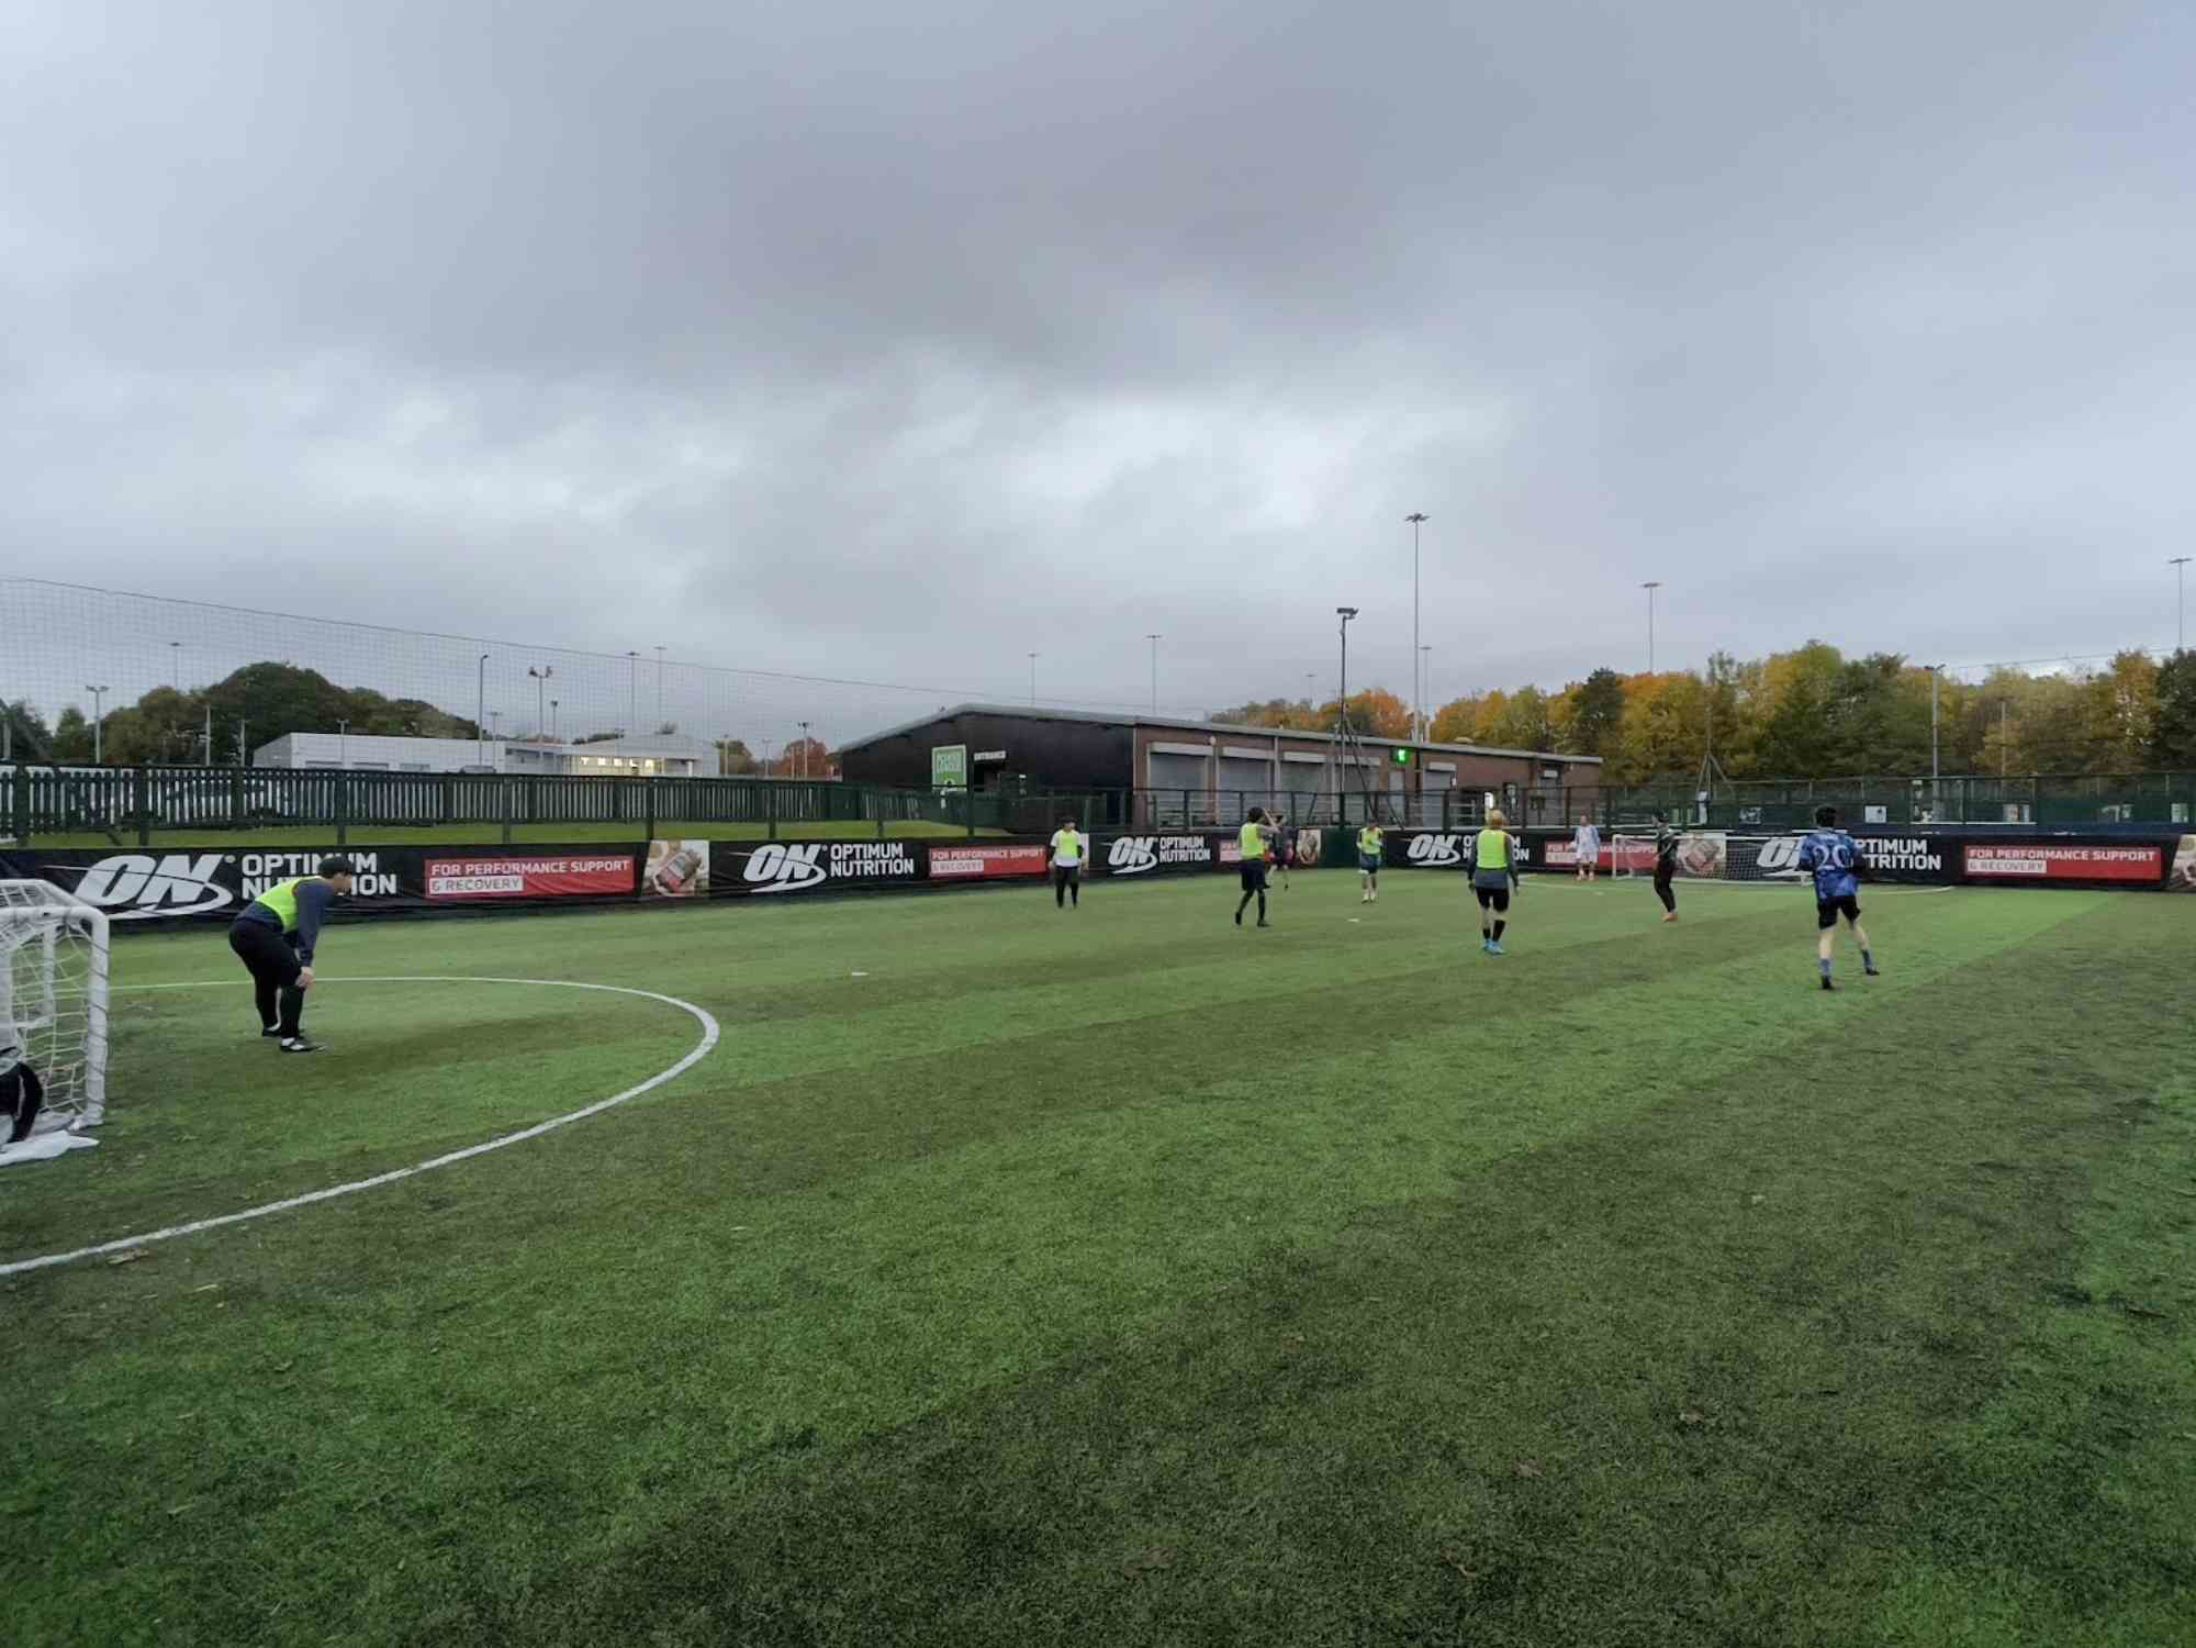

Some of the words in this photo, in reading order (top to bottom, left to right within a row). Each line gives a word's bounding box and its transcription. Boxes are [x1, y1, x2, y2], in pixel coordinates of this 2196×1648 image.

[830, 843, 903, 859] OPTIMUM
[1159, 837, 1204, 850] OPTIMUM
[1854, 838, 1927, 854] PTIMUM
[1108, 837, 1158, 872] ON
[1159, 848, 1211, 862] NUTRITION
[1812, 844, 1854, 871] 20
[1970, 850, 1993, 859] FOR
[1997, 850, 2088, 861] PERFORMANCE
[2093, 850, 2155, 862] SUPPORT
[432, 863, 461, 876] FOR
[465, 860, 566, 875] PERFORMANCE
[571, 859, 630, 873] SUPPORT
[743, 844, 826, 889] ON
[830, 858, 914, 877] NUTRITION
[1981, 861, 2044, 871] RECOVERY
[74, 854, 234, 915] ON
[445, 877, 519, 891] RECOVERY
